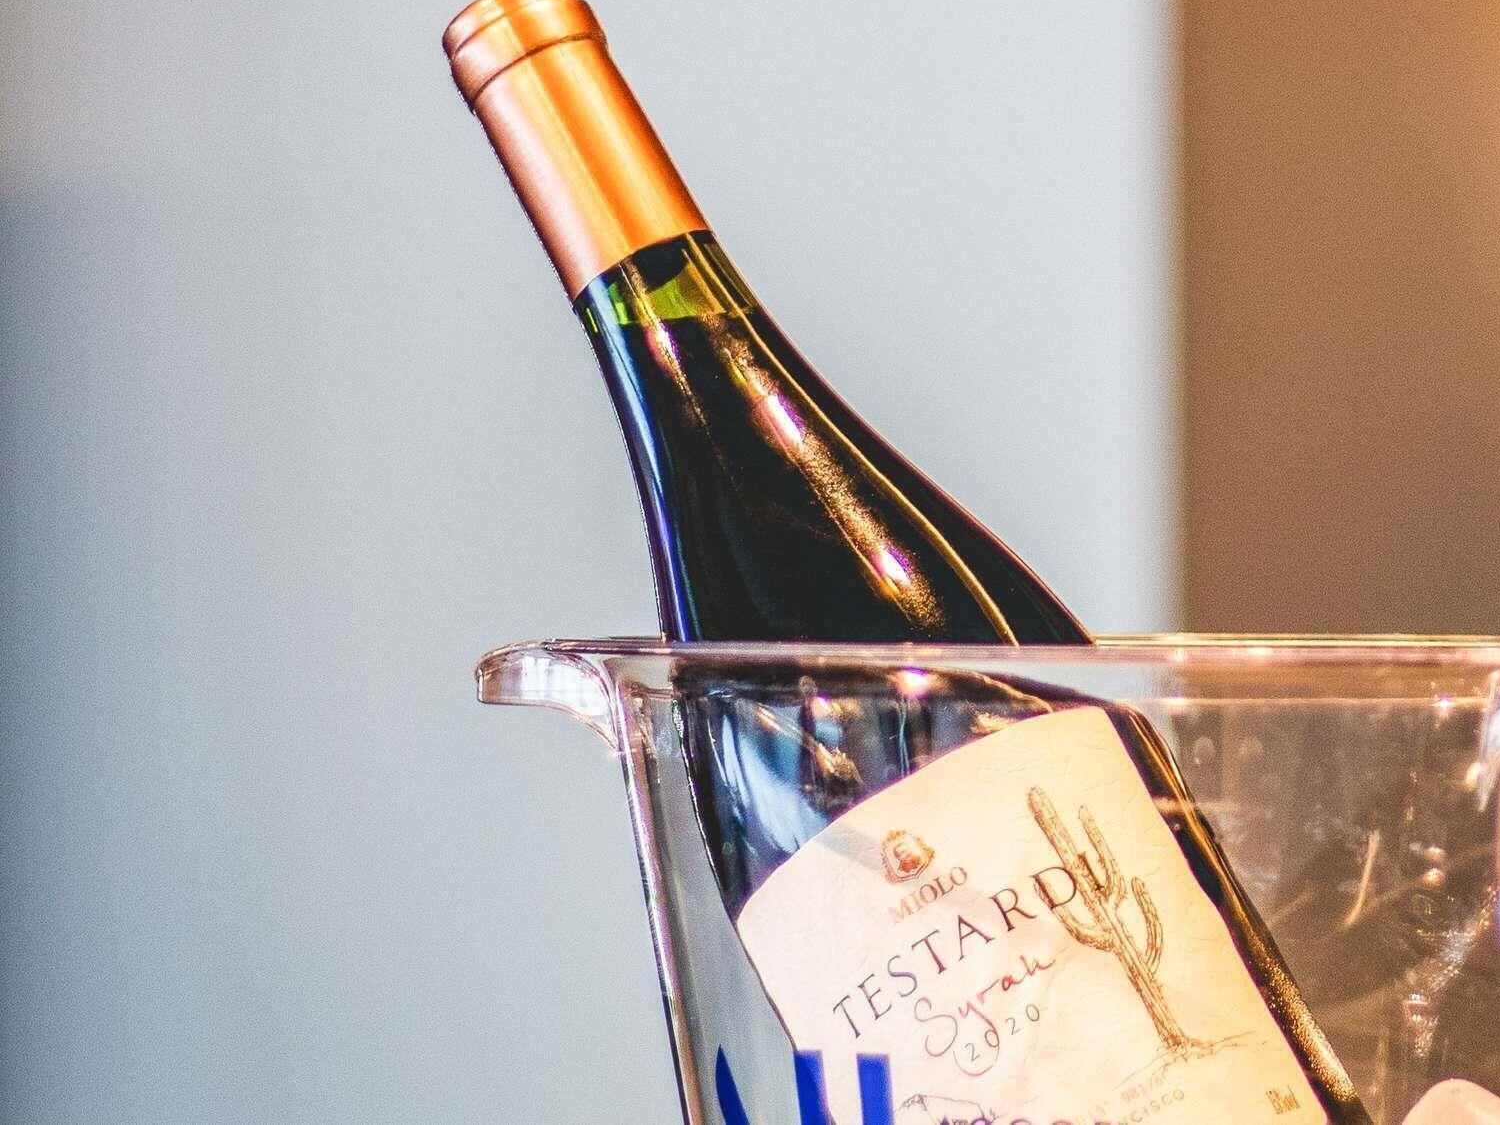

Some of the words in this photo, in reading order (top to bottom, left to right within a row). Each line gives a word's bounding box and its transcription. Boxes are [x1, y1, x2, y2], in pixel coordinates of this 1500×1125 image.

[888, 866, 968, 924] MIOLO
[832, 851, 1106, 1039] TESTARDI
[913, 954, 1056, 1077] Syrah
[964, 1003, 1040, 1062] 2020
[1117, 1088, 1185, 1125] NCISCO
